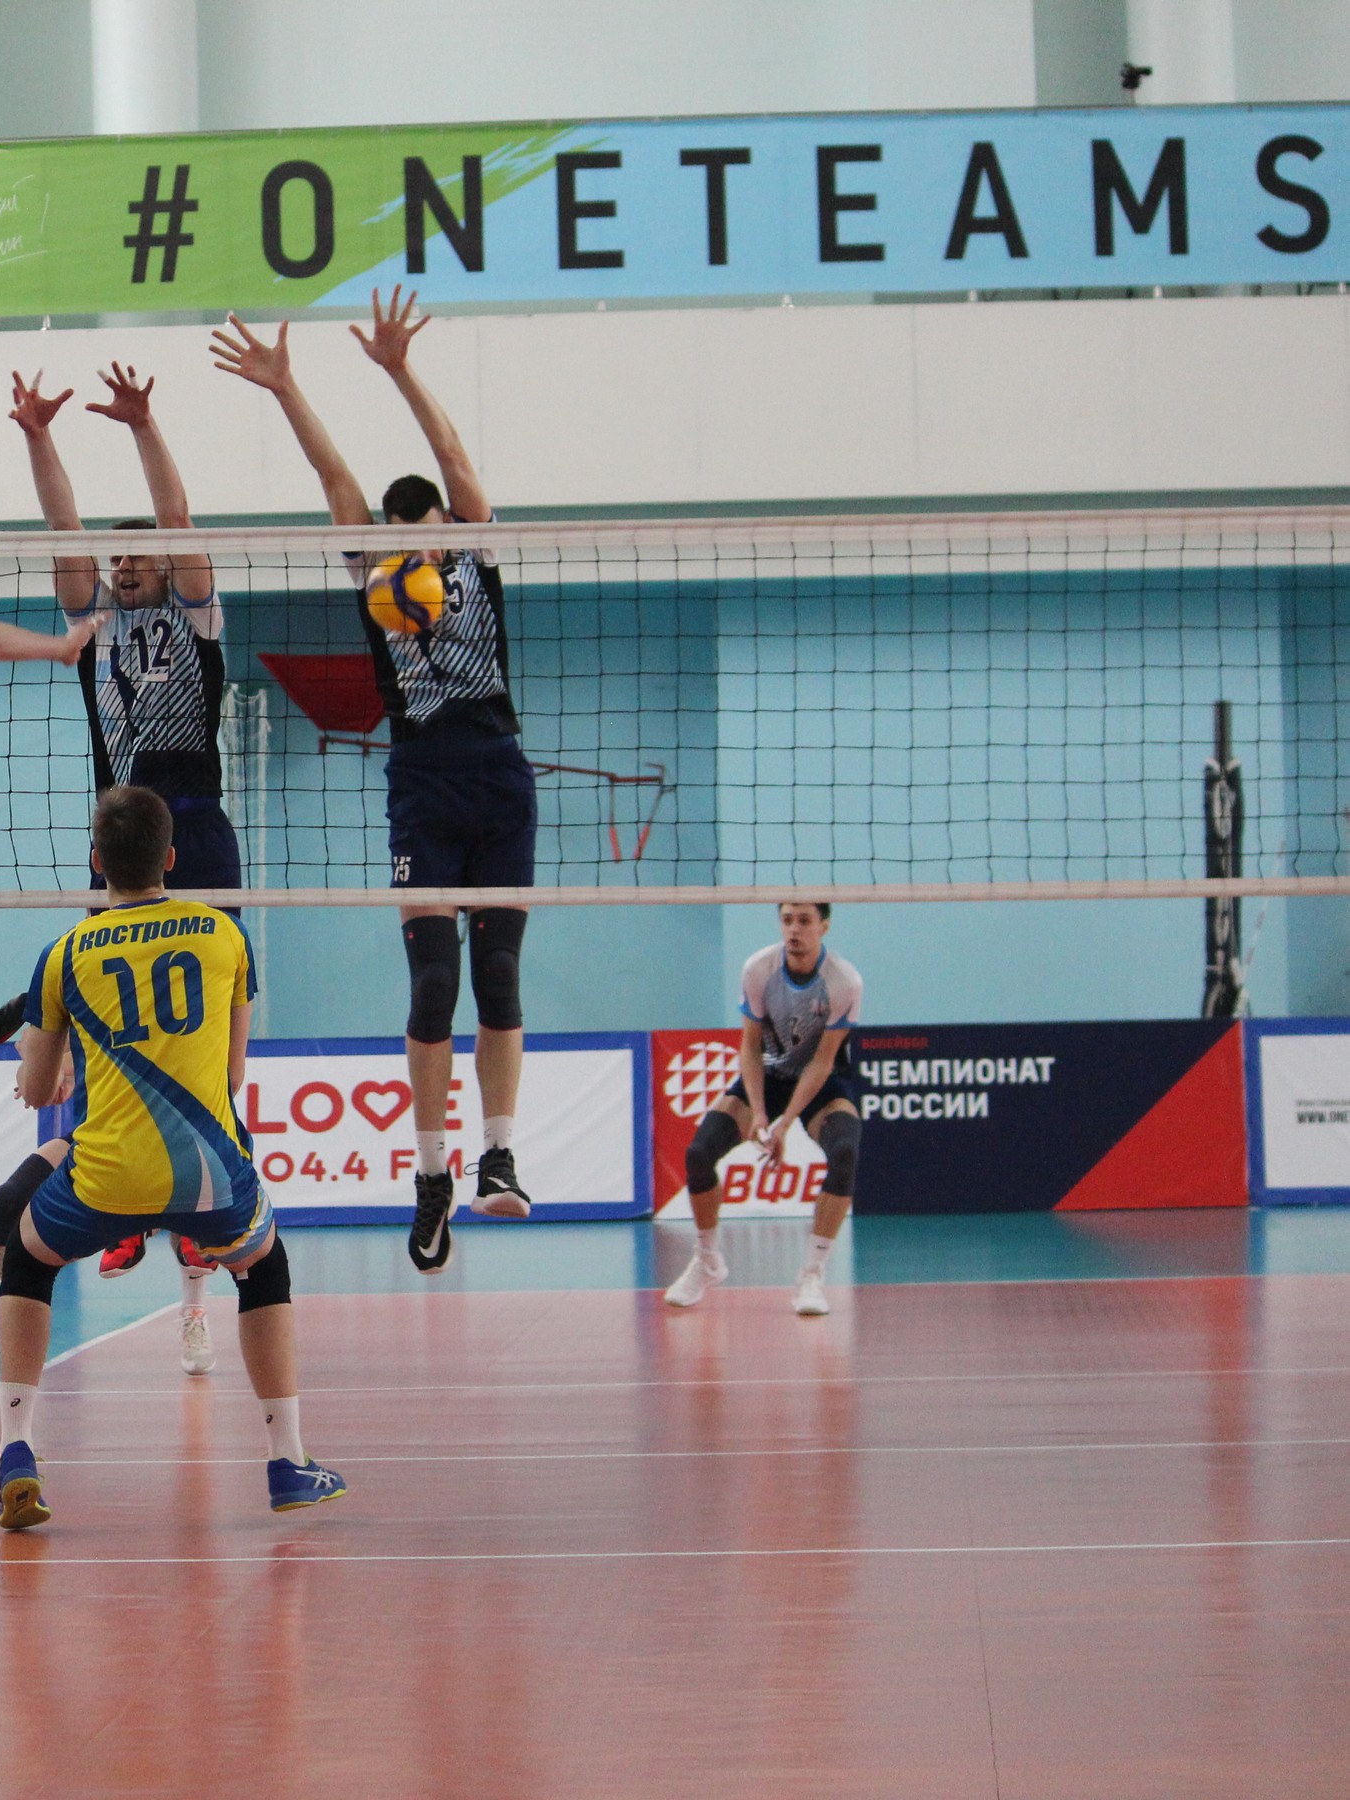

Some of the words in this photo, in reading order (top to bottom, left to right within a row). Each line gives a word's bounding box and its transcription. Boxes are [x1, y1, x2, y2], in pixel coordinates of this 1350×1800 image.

[123, 135, 1332, 284] #ONETEAMS
[129, 618, 173, 674] 12
[102, 950, 205, 1049] 10
[859, 1056, 1056, 1087] ЧЕМПИОНАТ
[861, 1092, 989, 1121] РОССИИ
[262, 1150, 369, 1182] 04.4
